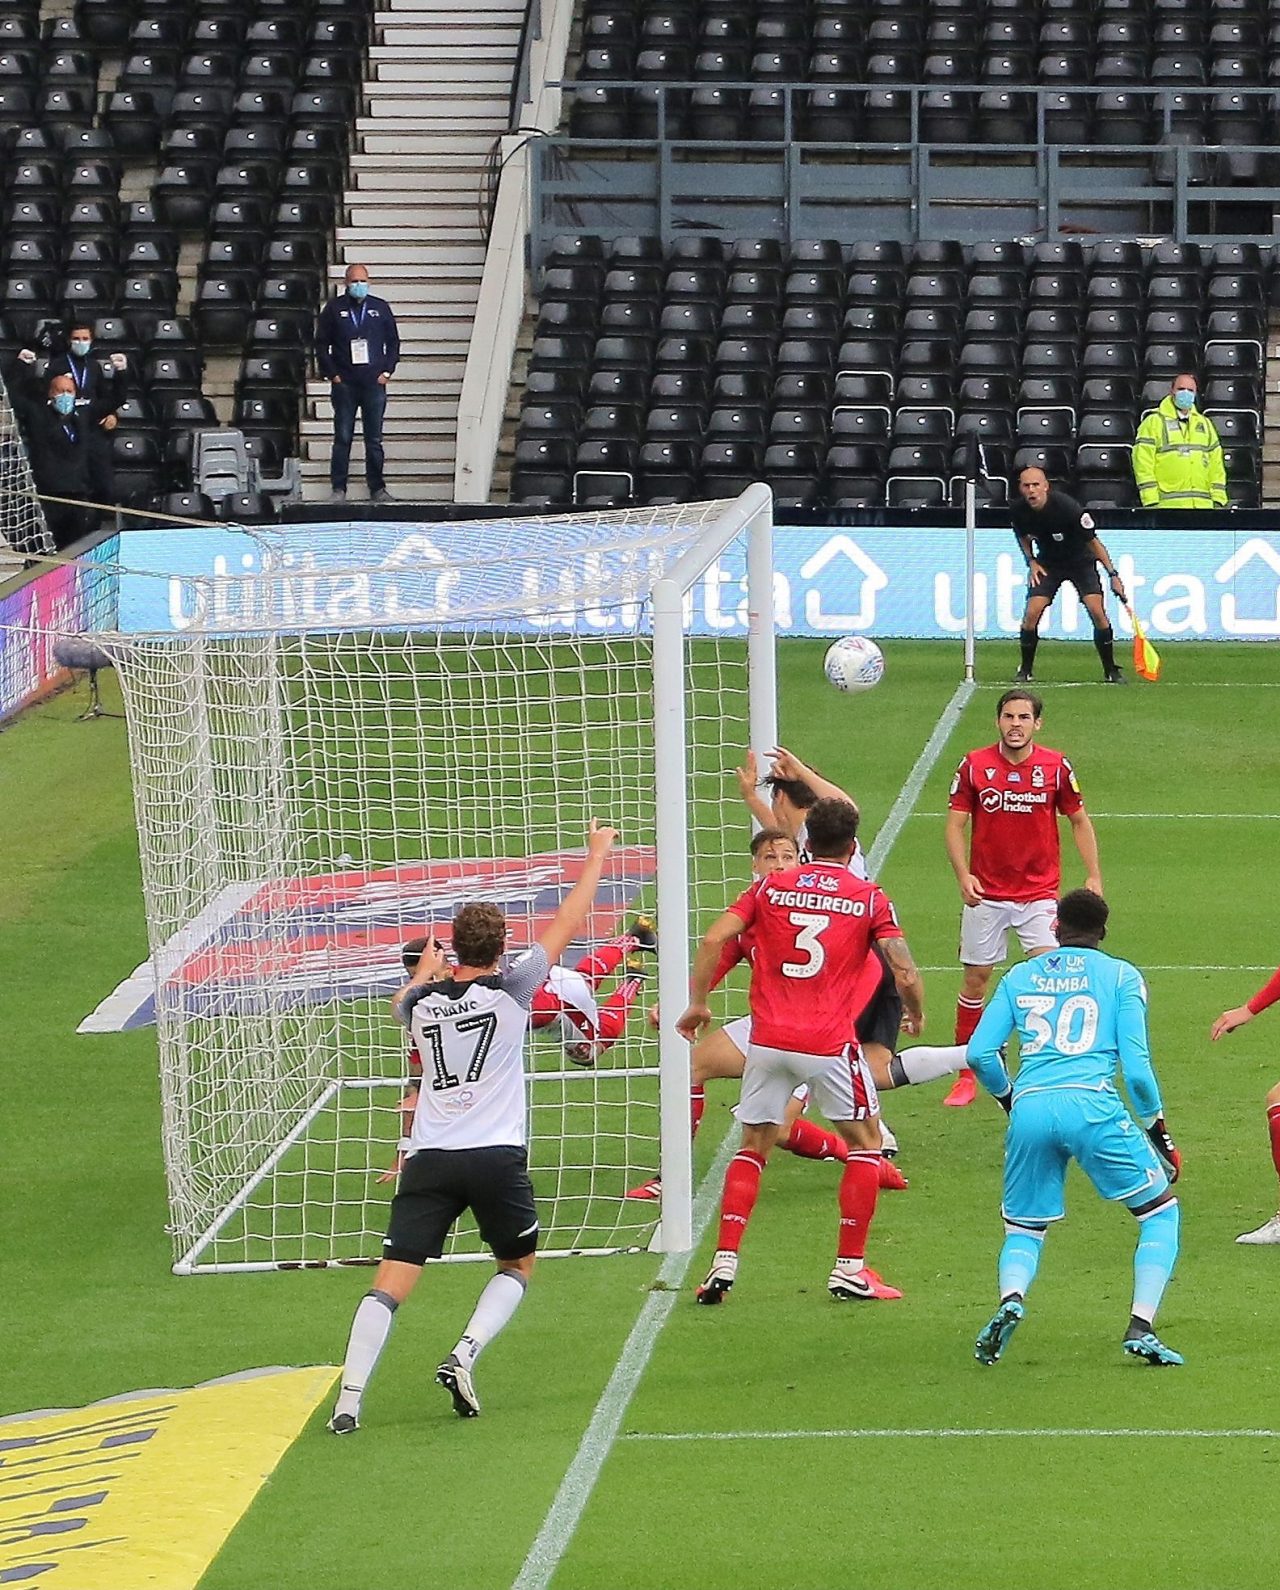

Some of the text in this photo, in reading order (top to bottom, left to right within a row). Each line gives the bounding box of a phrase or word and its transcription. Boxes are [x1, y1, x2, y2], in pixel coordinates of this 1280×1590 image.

[934, 552, 1209, 634] utlta
[1003, 791, 1048, 804] Football
[1003, 802, 1033, 813] Index
[770, 890, 865, 918] FIGUEIREDO
[782, 911, 830, 979] 3
[1066, 955, 1087, 967] UK
[1035, 975, 1089, 993] SAMBA
[1016, 994, 1099, 1056] 30
[421, 1011, 498, 1091] 17
